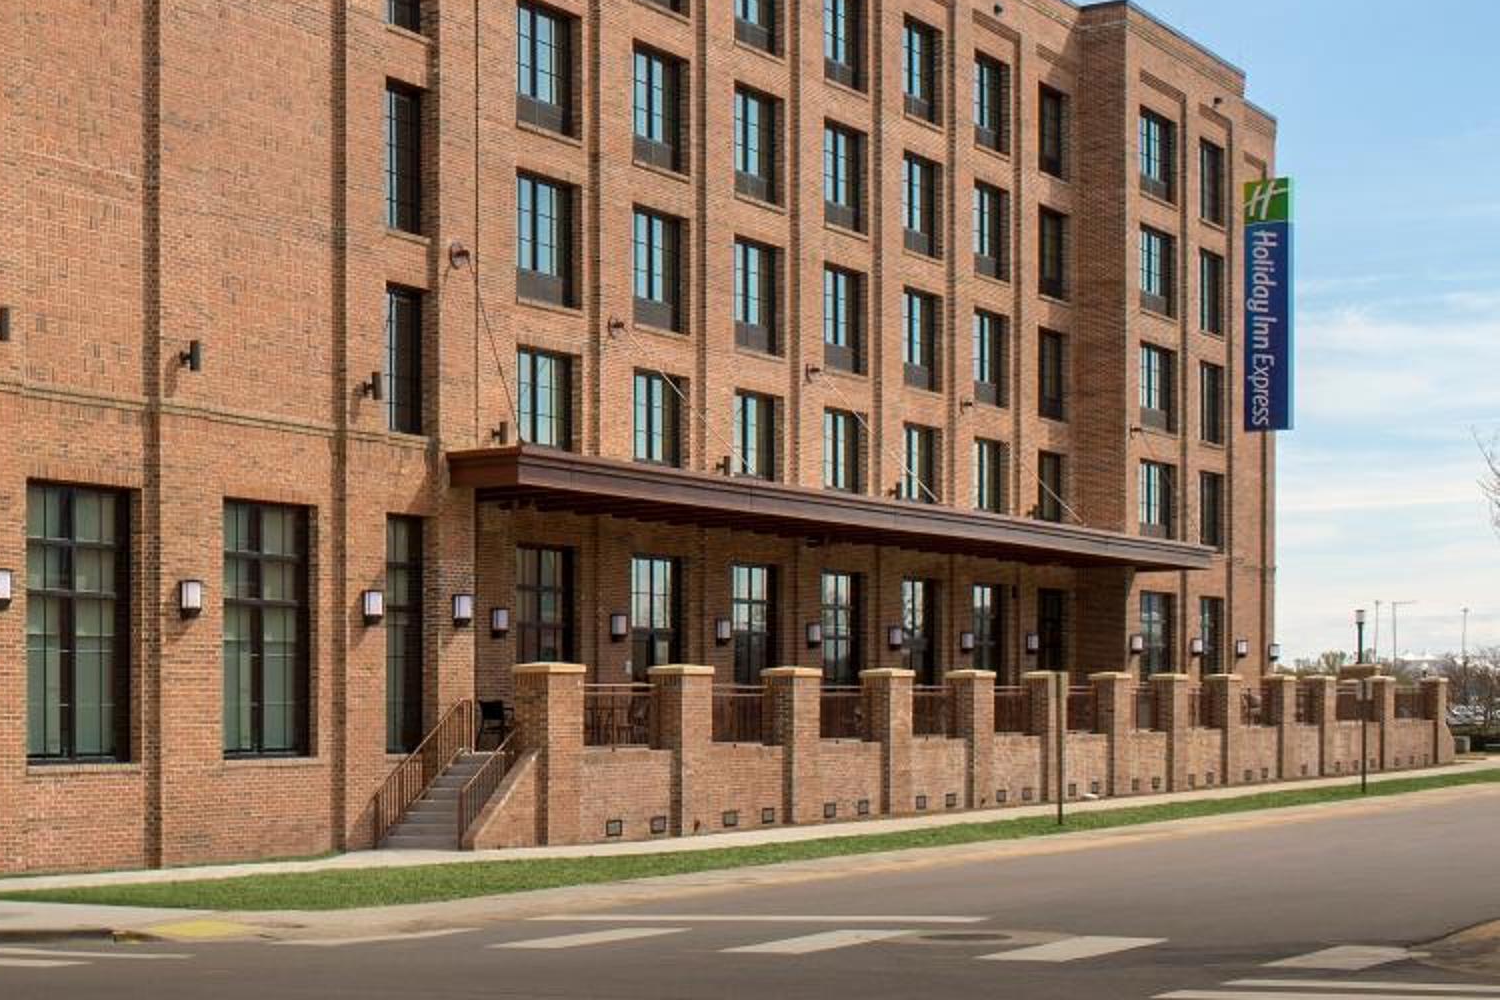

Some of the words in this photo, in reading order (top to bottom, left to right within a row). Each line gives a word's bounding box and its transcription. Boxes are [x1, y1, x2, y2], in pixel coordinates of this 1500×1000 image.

[1246, 230, 1277, 312] Holiday
[1252, 315, 1278, 349] Inn
[1247, 354, 1275, 425] Express
